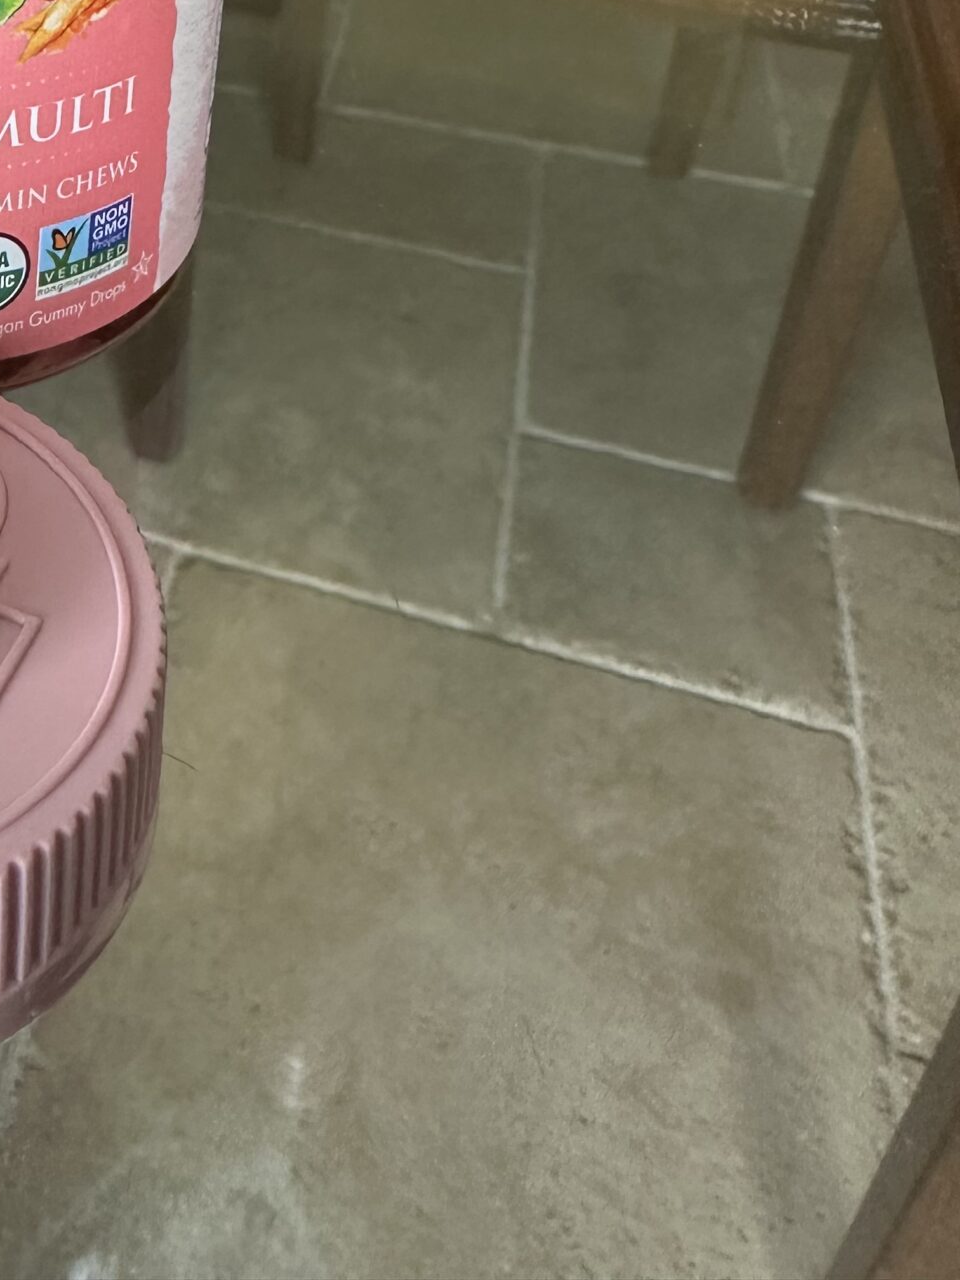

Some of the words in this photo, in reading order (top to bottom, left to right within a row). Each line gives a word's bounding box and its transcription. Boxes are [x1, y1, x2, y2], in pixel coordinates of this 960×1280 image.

[56, 151, 139, 201] CHEWS
[92, 216, 128, 240] GMO
[94, 201, 129, 227] NON
[91, 228, 127, 252] Project
[45, 243, 126, 283] VERIFIED
[29, 301, 87, 328] Gummy
[90, 281, 127, 308] Drops
